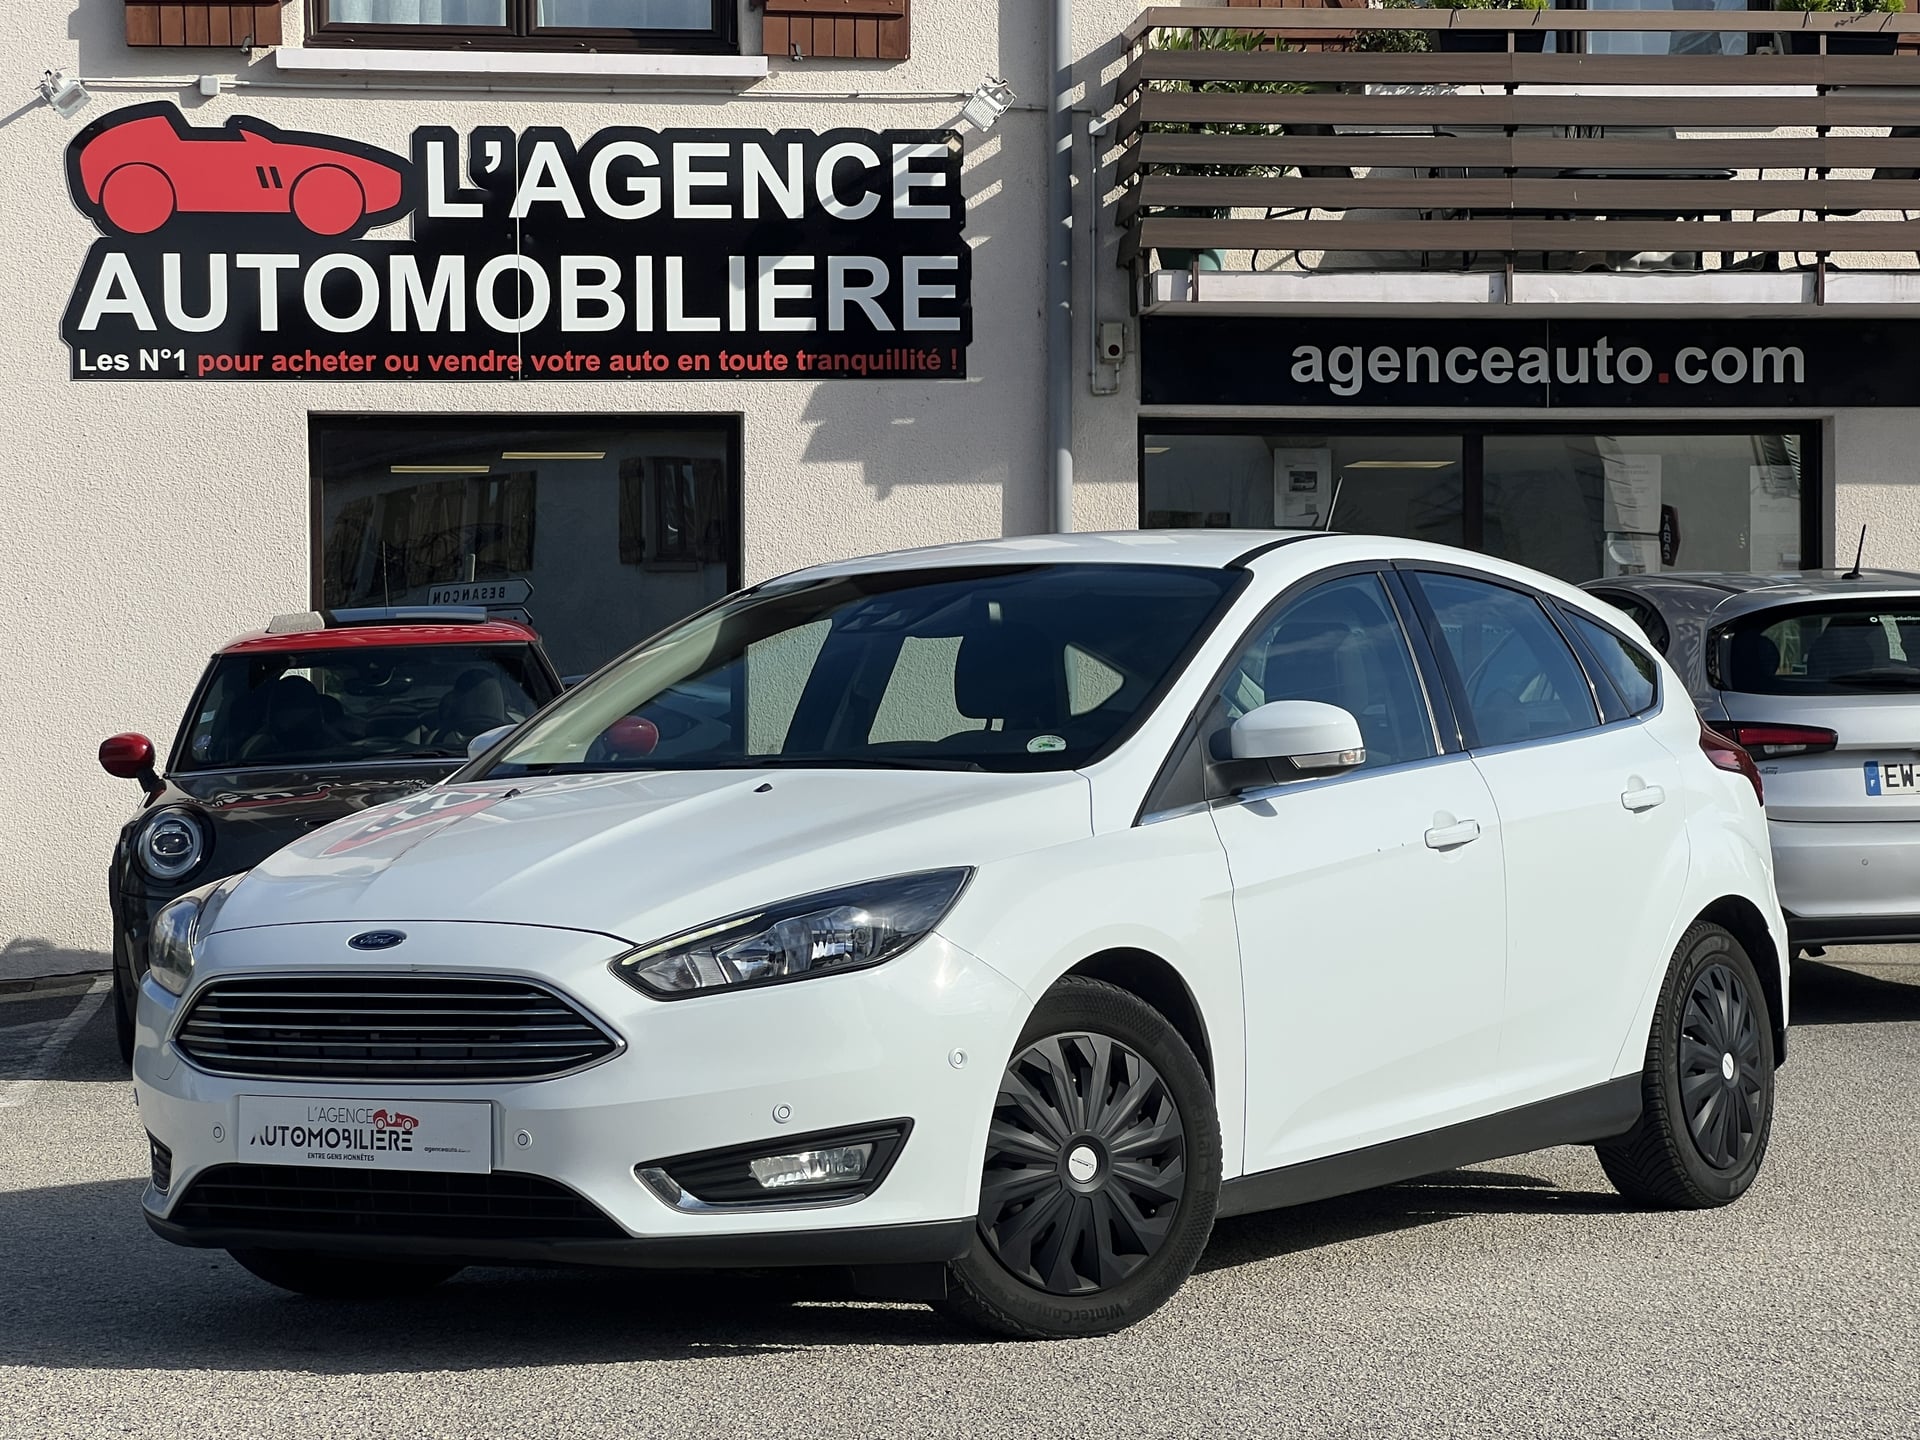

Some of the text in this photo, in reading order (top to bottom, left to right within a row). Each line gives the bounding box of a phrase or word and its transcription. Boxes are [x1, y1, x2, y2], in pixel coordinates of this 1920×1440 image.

[426, 140, 951, 220] L'AGENCE
[78, 253, 961, 333] AUTOMOBILIERE
[79, 348, 130, 372] Les
[139, 348, 187, 372] N°1
[197, 354, 264, 376] pour
[271, 349, 377, 373] acheter
[384, 354, 419, 372] ou
[427, 349, 523, 372] vendre
[530, 350, 601, 372] votre
[609, 350, 670, 372] auto
[677, 353, 710, 372] en
[718, 350, 789, 371] toute
[796, 348, 942, 376] tranquillité
[1290, 336, 1805, 396] agenceauto.com
[307, 1106, 374, 1124] L'AGENCE
[307, 1152, 326, 1160] ENTRE
